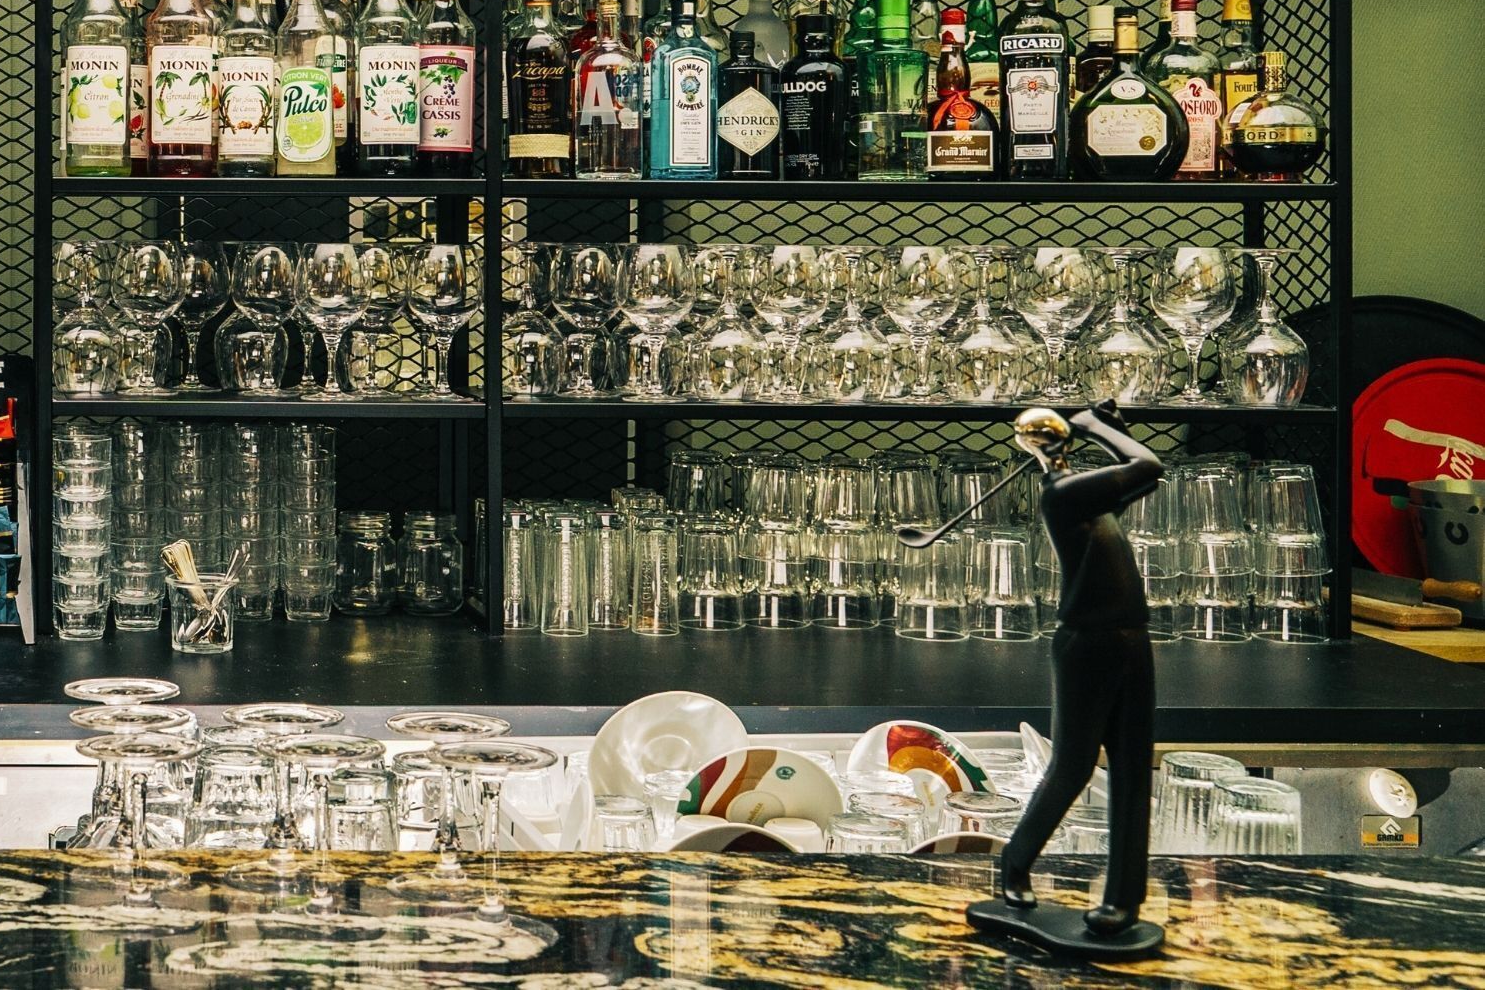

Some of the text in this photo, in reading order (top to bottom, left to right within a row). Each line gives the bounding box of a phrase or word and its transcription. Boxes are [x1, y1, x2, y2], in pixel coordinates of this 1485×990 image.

[1003, 38, 1061, 50] RICARD
[71, 60, 119, 71] MONIN
[159, 60, 209, 71] MONIN
[368, 60, 416, 71] MONIN
[677, 63, 704, 76] BOMBAY
[221, 72, 270, 82] MONIN
[310, 72, 328, 83] VERT
[1233, 81, 1252, 93] Four
[283, 85, 328, 118] Pulco
[423, 95, 460, 107] CRÈME
[675, 99, 705, 111] SAPPHIRE
[1181, 100, 1218, 116] OSFORD
[422, 110, 461, 121] CASSIS
[935, 146, 959, 157] Grand
